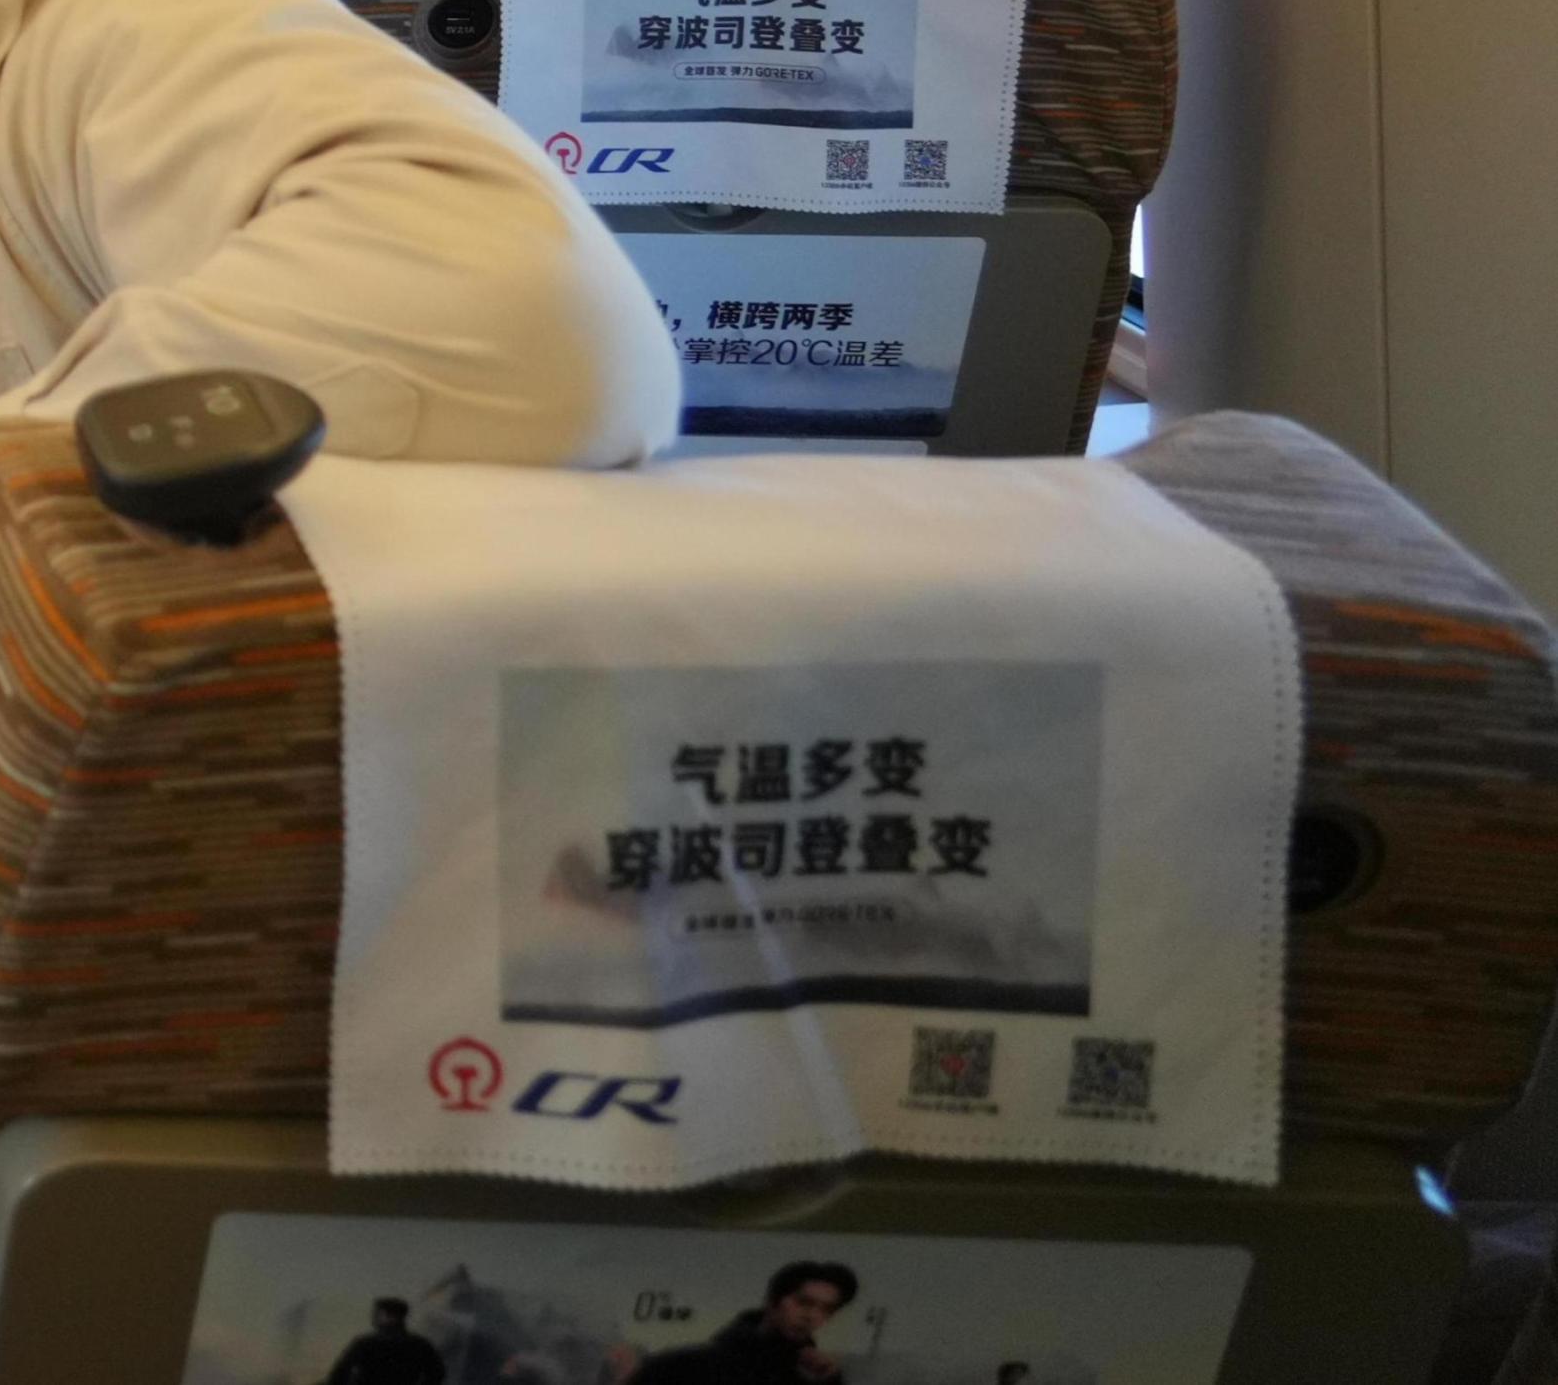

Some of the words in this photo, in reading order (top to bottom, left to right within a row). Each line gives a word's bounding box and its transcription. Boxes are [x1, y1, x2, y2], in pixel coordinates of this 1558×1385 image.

[637, 15, 866, 57] 穿波司登叠变
[674, 336, 906, 369] 掌控20℃温差
[669, 737, 929, 807] 气温多变
[605, 818, 993, 893] 穿波司登叠变
